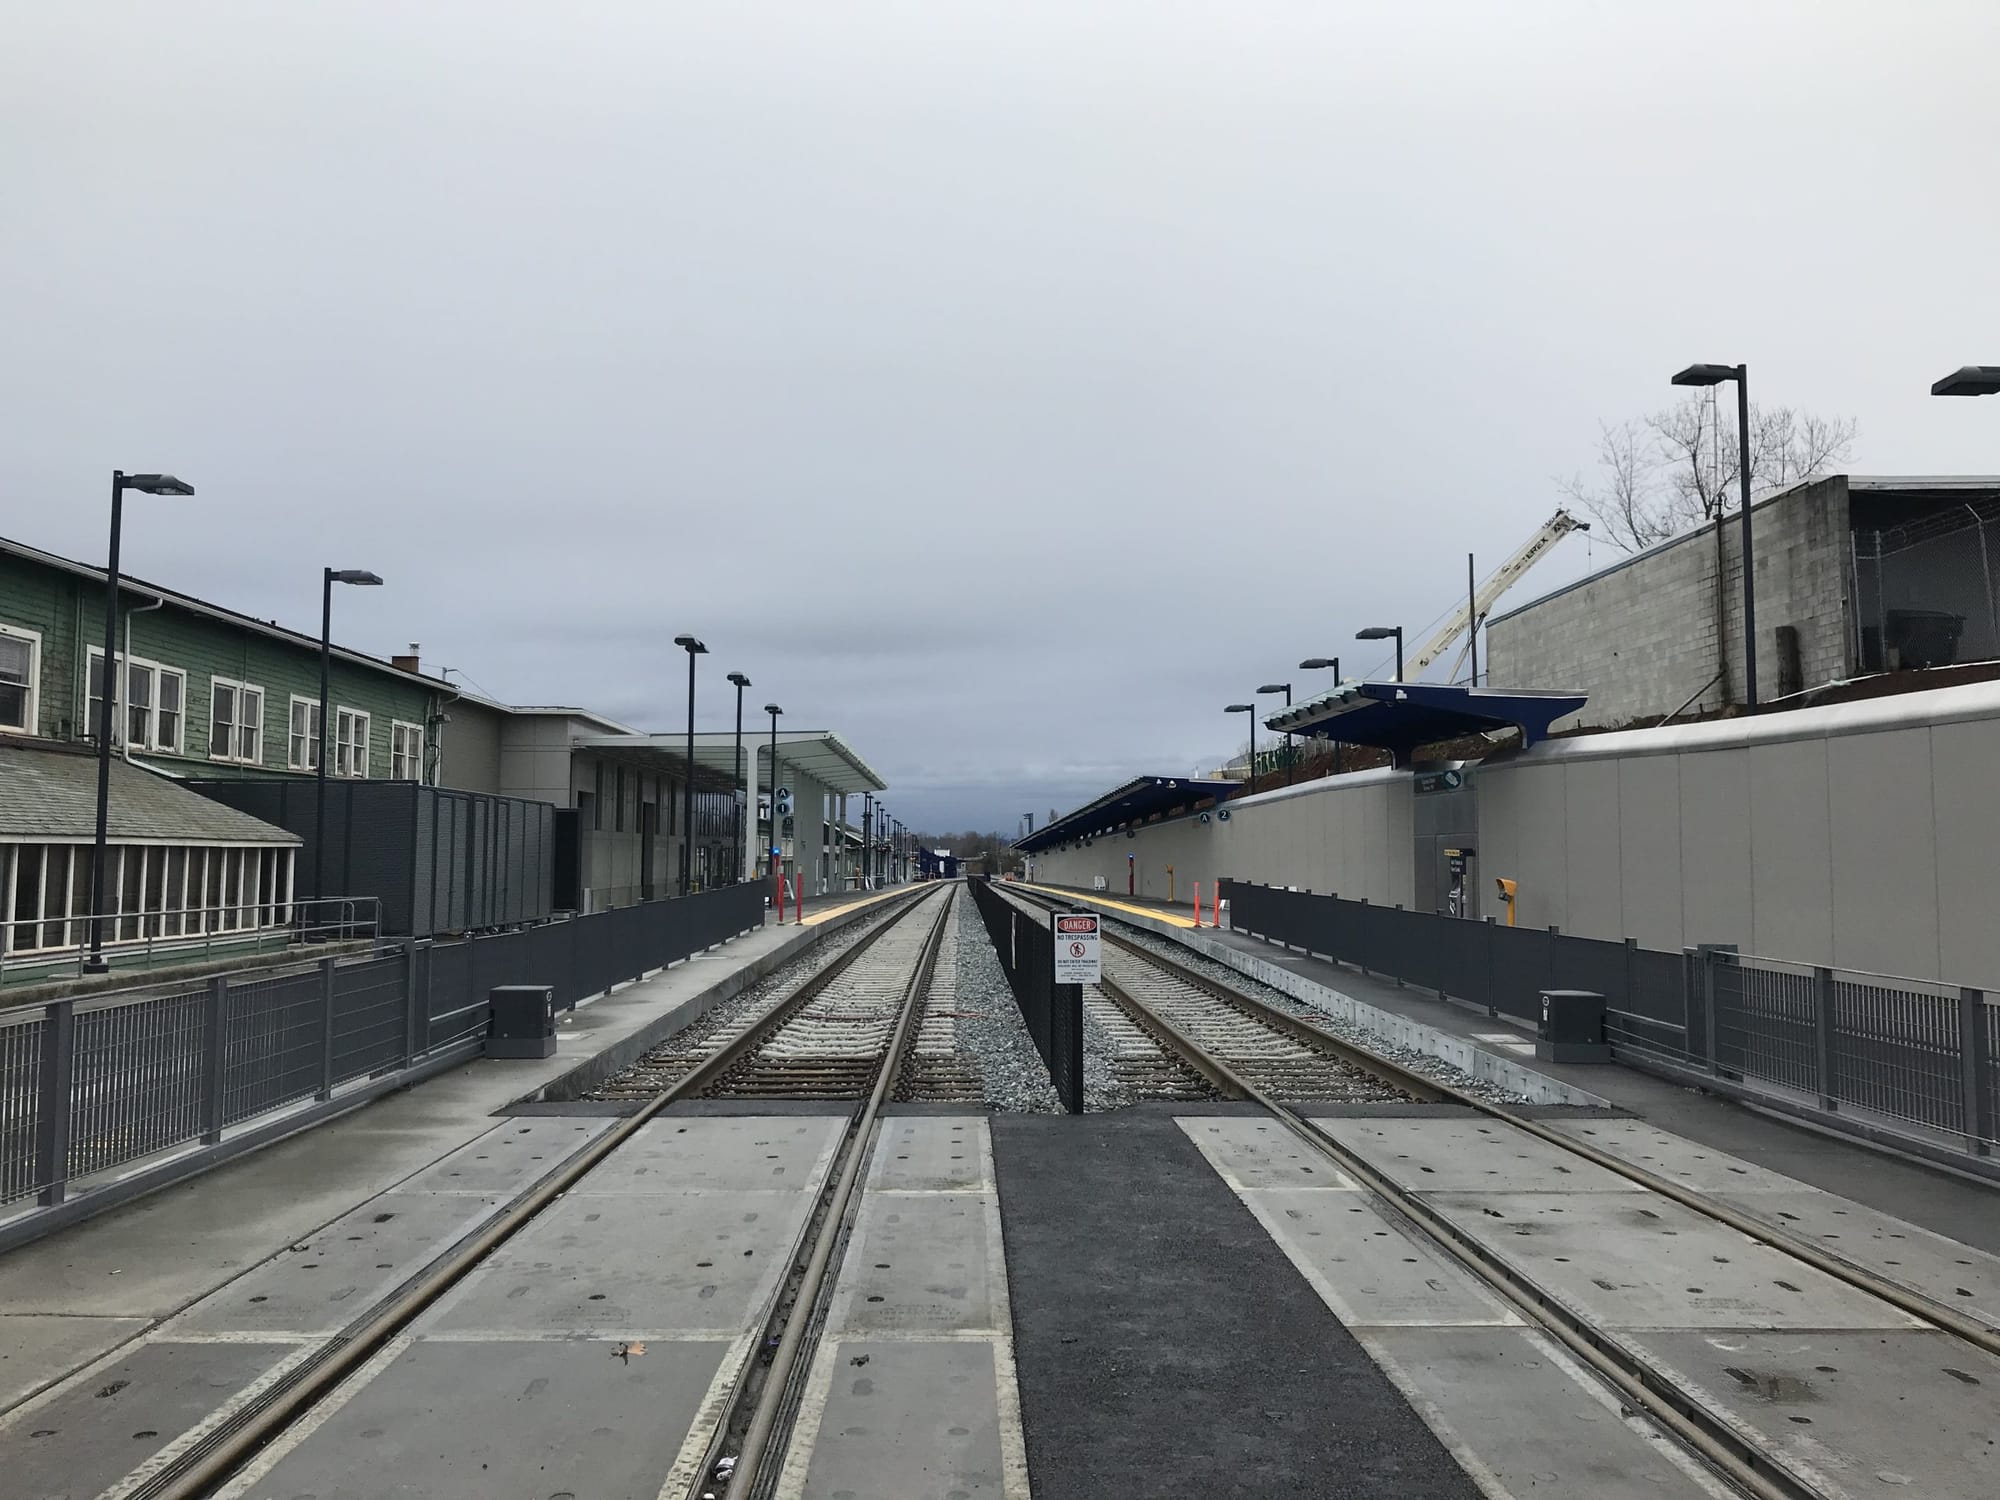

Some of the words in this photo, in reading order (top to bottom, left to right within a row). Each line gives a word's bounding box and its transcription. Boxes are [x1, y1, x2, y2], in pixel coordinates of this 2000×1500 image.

[780, 789, 786, 797] A
[1202, 814, 1208, 822] A
[1064, 920, 1090, 930] DANGER
